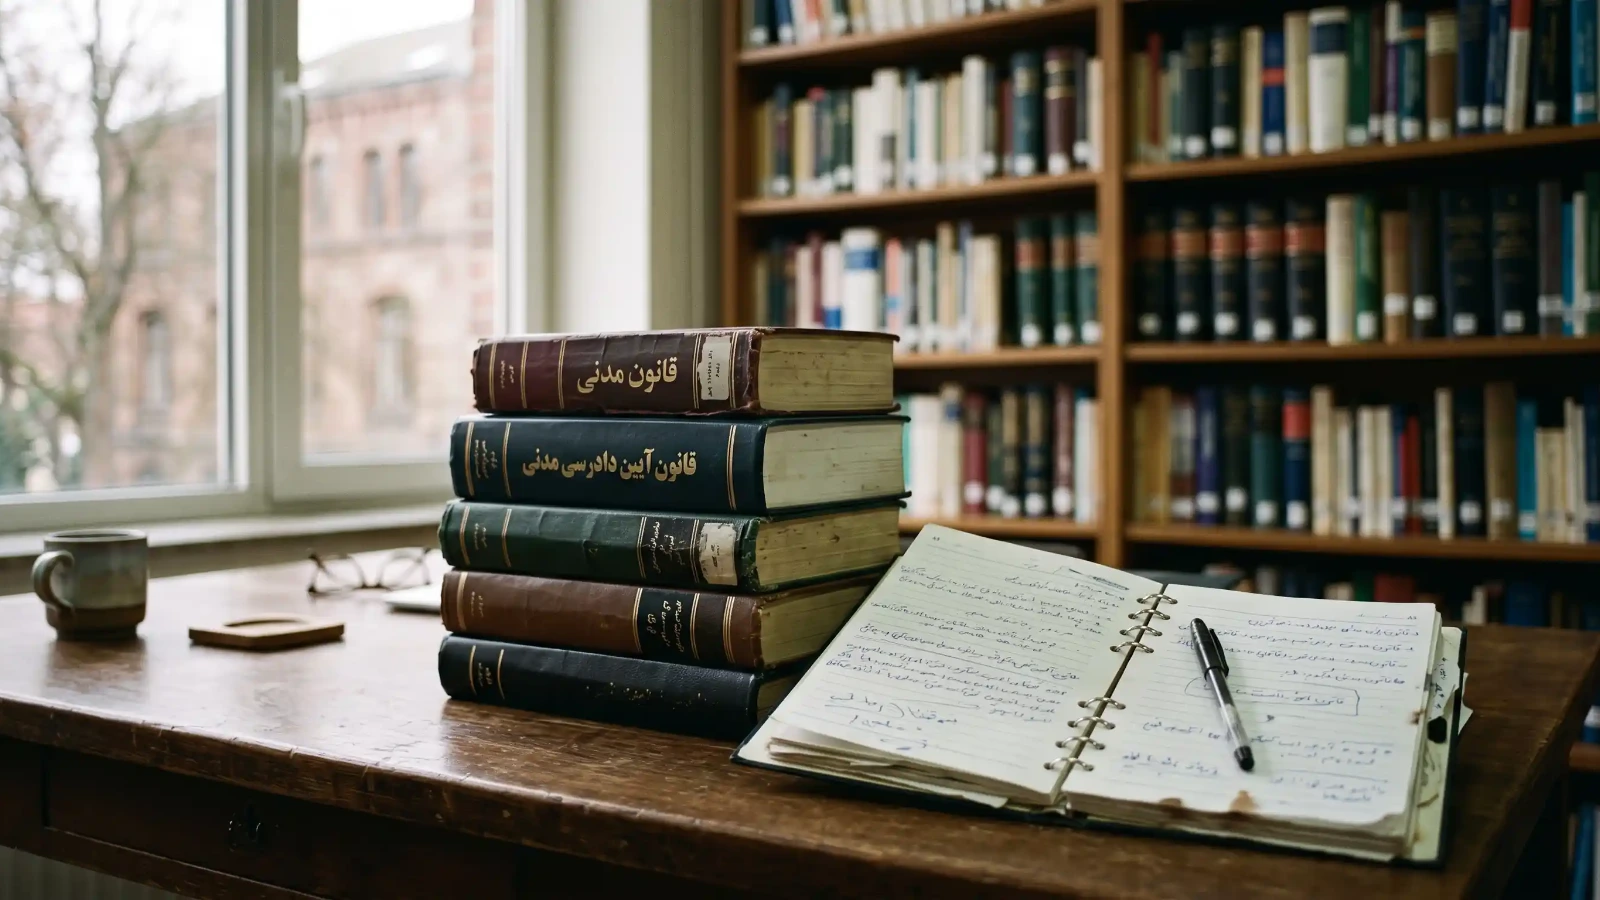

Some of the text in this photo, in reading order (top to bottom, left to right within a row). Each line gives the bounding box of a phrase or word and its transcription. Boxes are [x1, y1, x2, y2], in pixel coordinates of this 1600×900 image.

[577, 360, 624, 394] مدنی
[628, 356, 678, 393] قانون
[522, 448, 559, 476] مدنی
[561, 450, 618, 479] دادرسی
[619, 448, 655, 480] آیین
[655, 451, 697, 482] قانون
